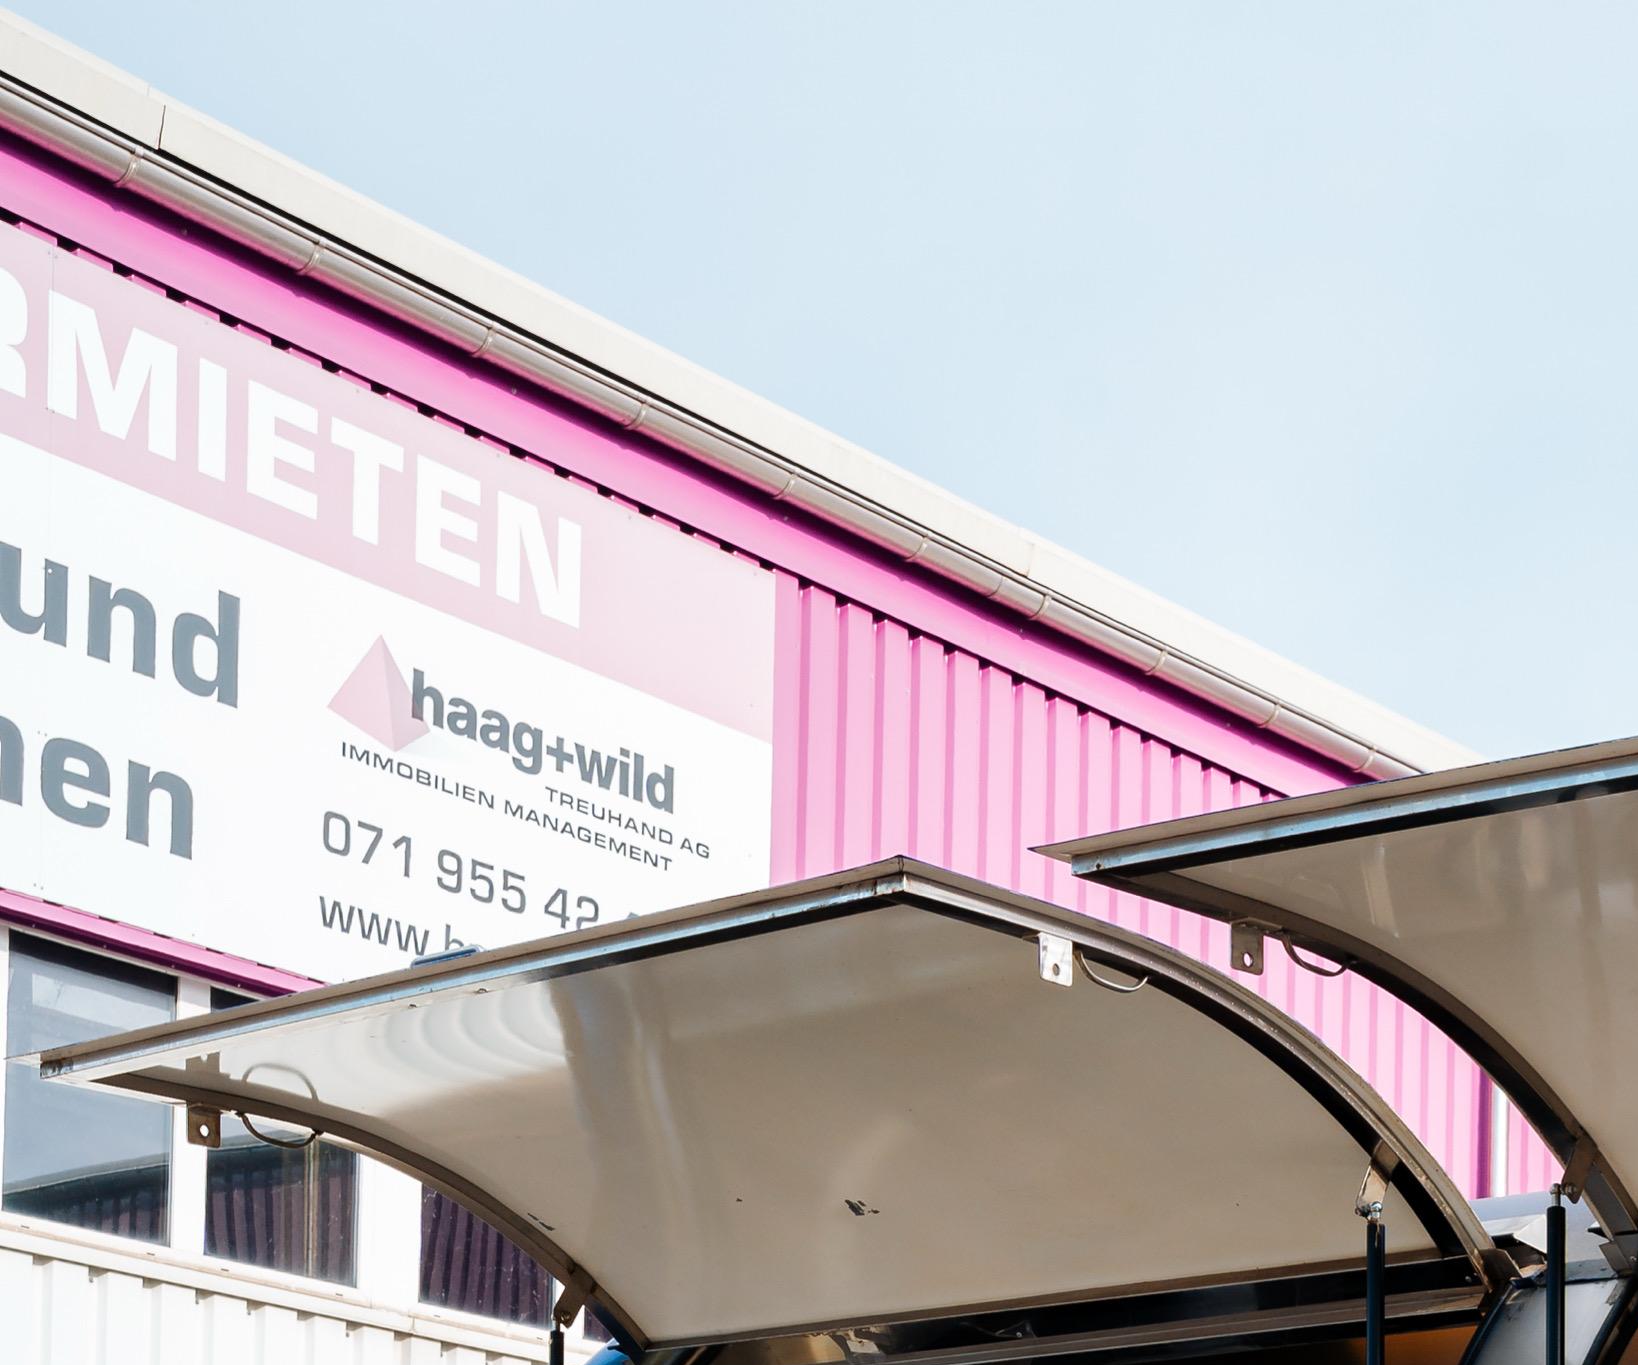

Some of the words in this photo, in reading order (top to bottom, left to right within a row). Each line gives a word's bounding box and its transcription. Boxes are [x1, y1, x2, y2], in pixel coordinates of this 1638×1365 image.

[0, 541, 241, 710] und
[341, 741, 496, 810] IMMOBILIEN
[504, 802, 673, 872] MANAGEMENT
[410, 668, 676, 815] haag+wild
[322, 810, 413, 878] 071
[436, 849, 528, 915] 955
[544, 888, 600, 931] 42
[545, 786, 674, 847] TREUHAND
[680, 839, 710, 860] AG
